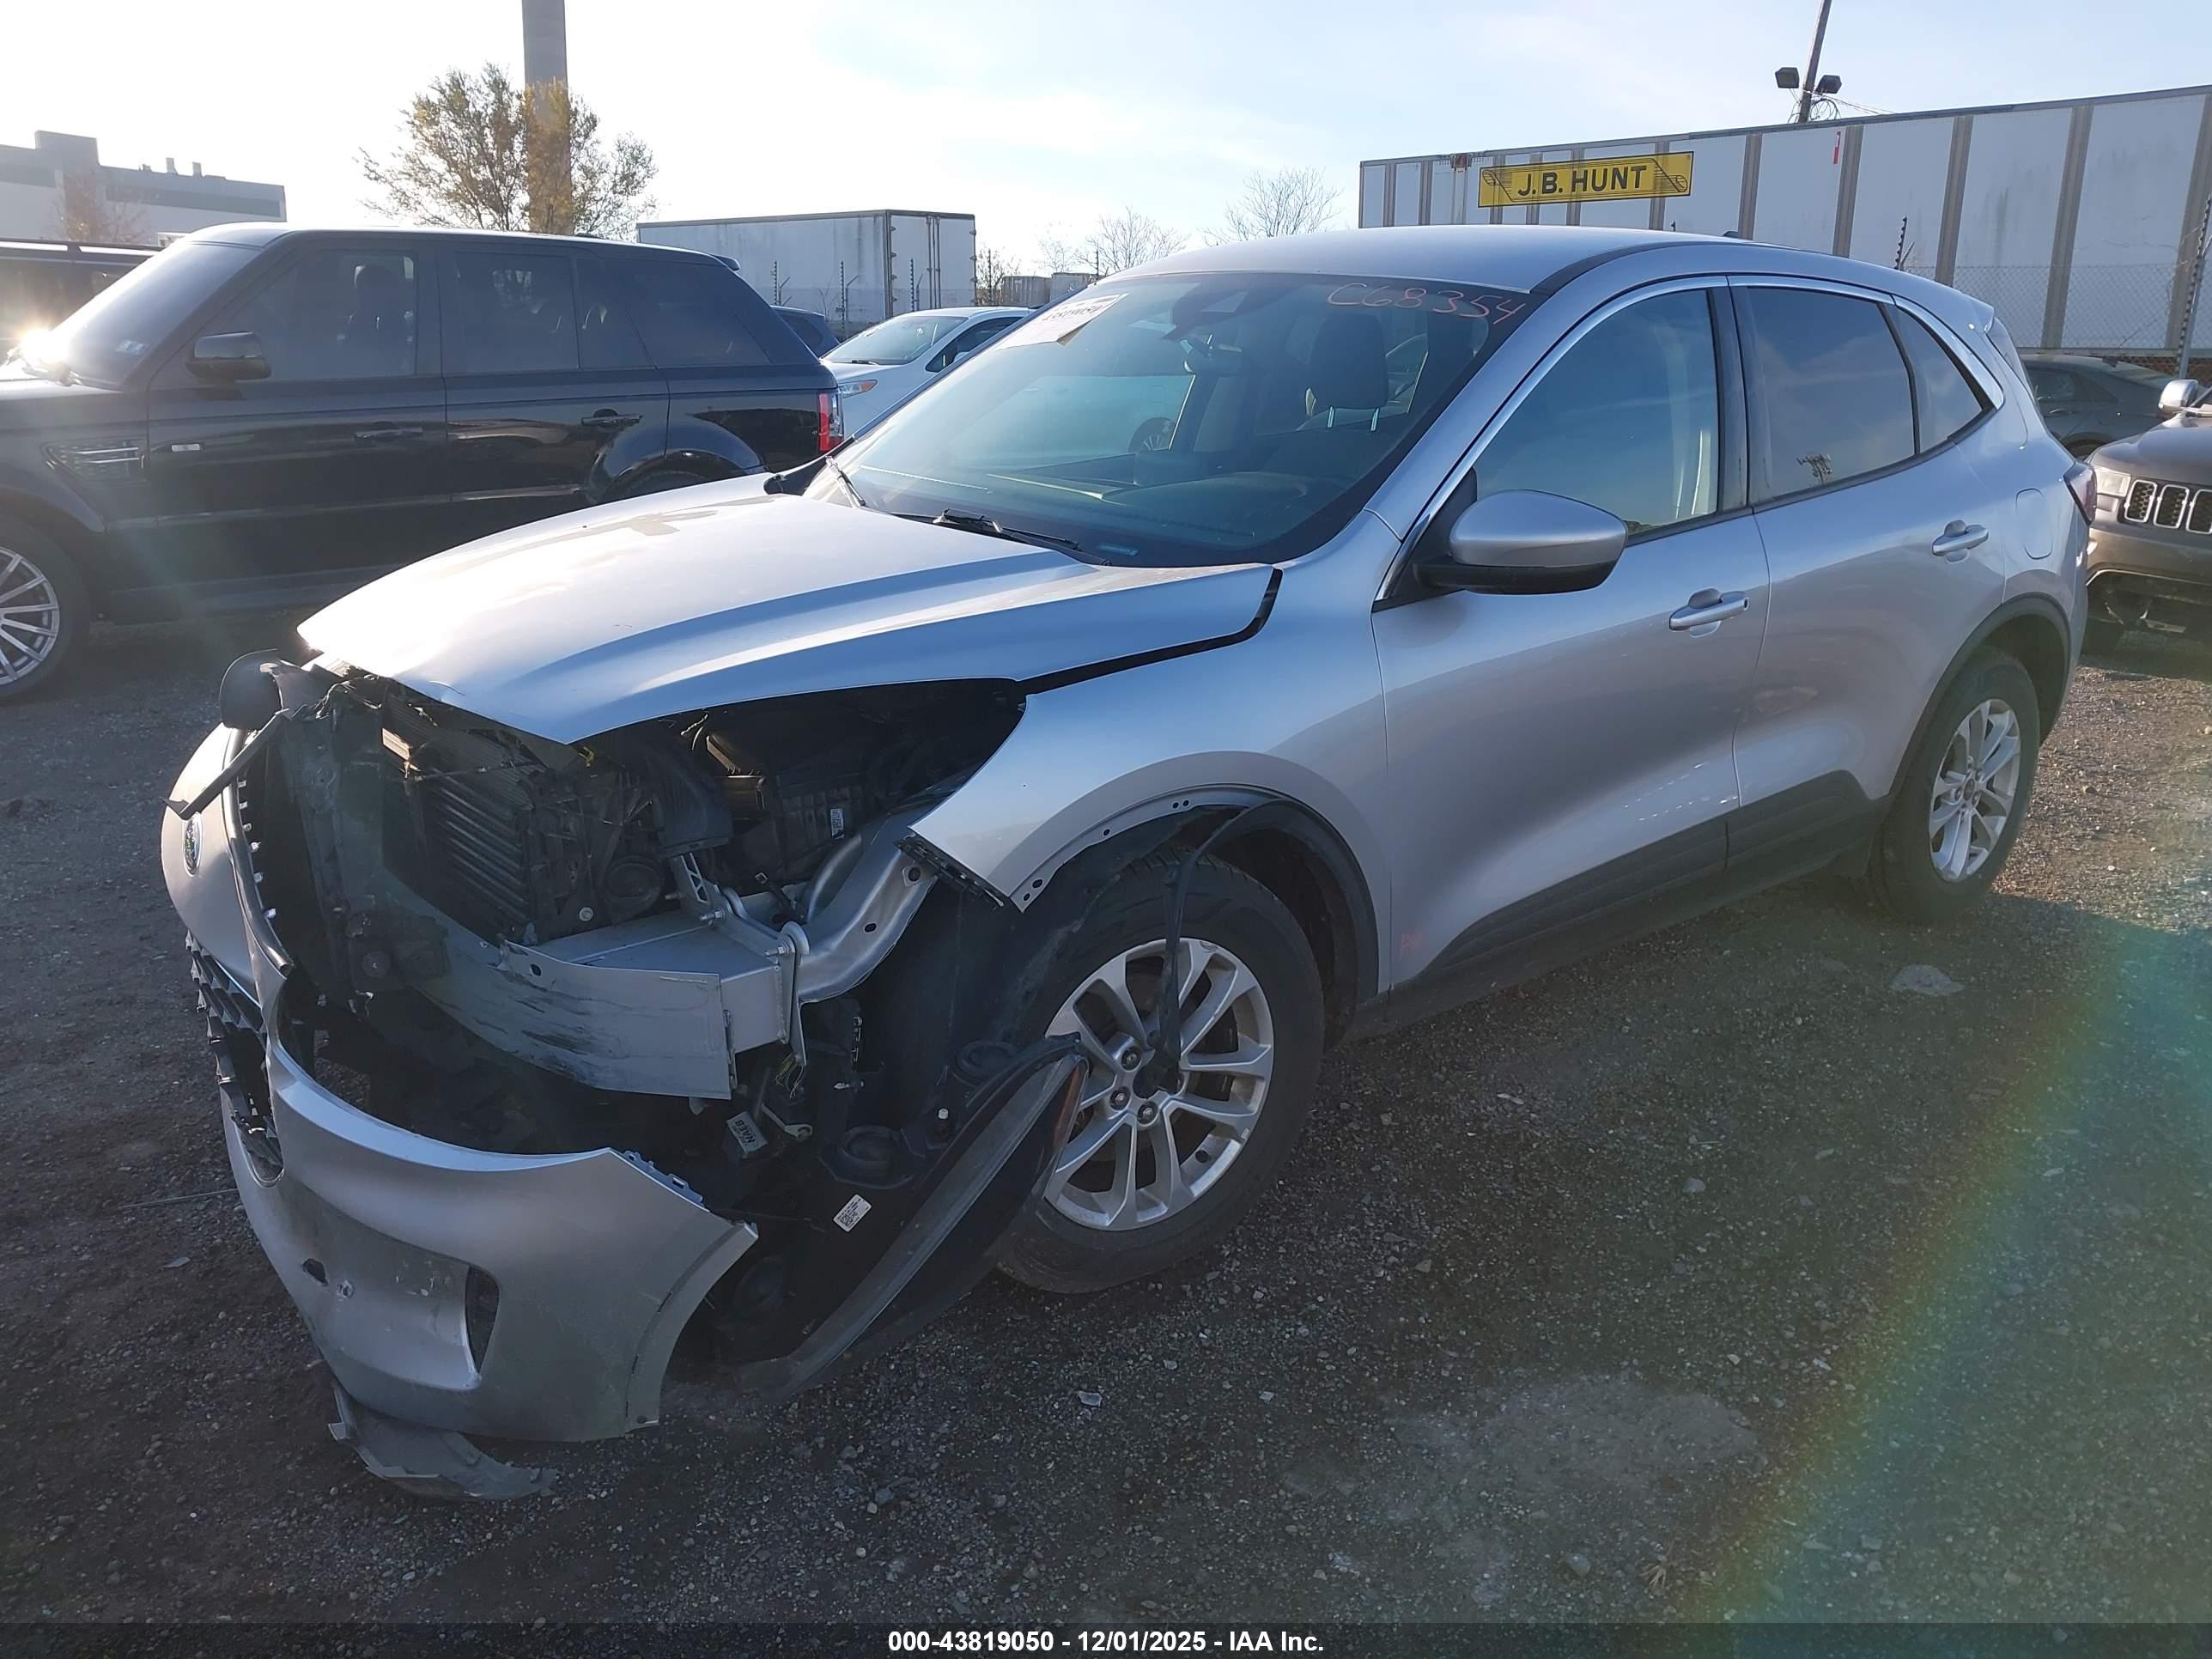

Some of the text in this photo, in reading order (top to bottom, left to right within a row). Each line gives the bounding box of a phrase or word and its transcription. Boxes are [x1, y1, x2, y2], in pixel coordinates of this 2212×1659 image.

[1517, 166, 1647, 196] J.B. HUNT
[1328, 283, 1526, 325] C68354
